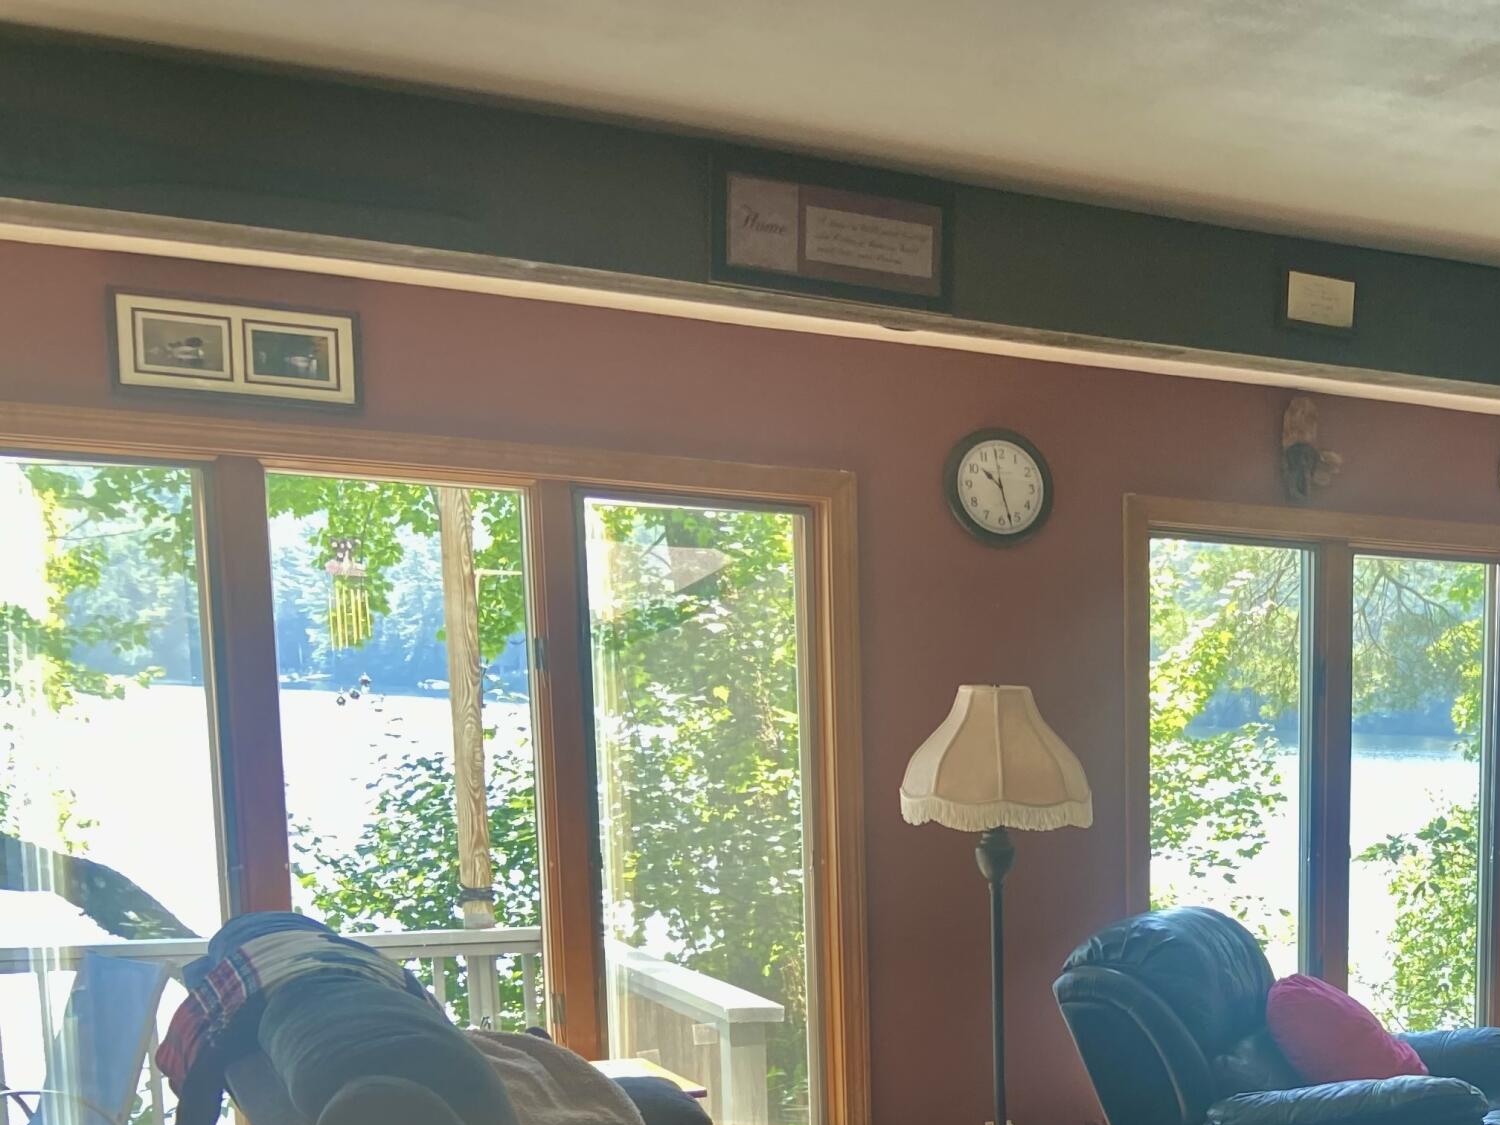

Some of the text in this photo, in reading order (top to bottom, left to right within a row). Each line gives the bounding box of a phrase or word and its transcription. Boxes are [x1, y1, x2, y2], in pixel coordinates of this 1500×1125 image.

[969, 463, 979, 474] 10
[1024, 466, 1031, 478] 2
[965, 480, 973, 490] 9
[1028, 484, 1035, 495] 3
[970, 496, 979, 507] 8
[1024, 500, 1031, 511] 4
[983, 509, 991, 521] 7
[1013, 511, 1022, 522] 5
[998, 515, 1006, 527] 6
